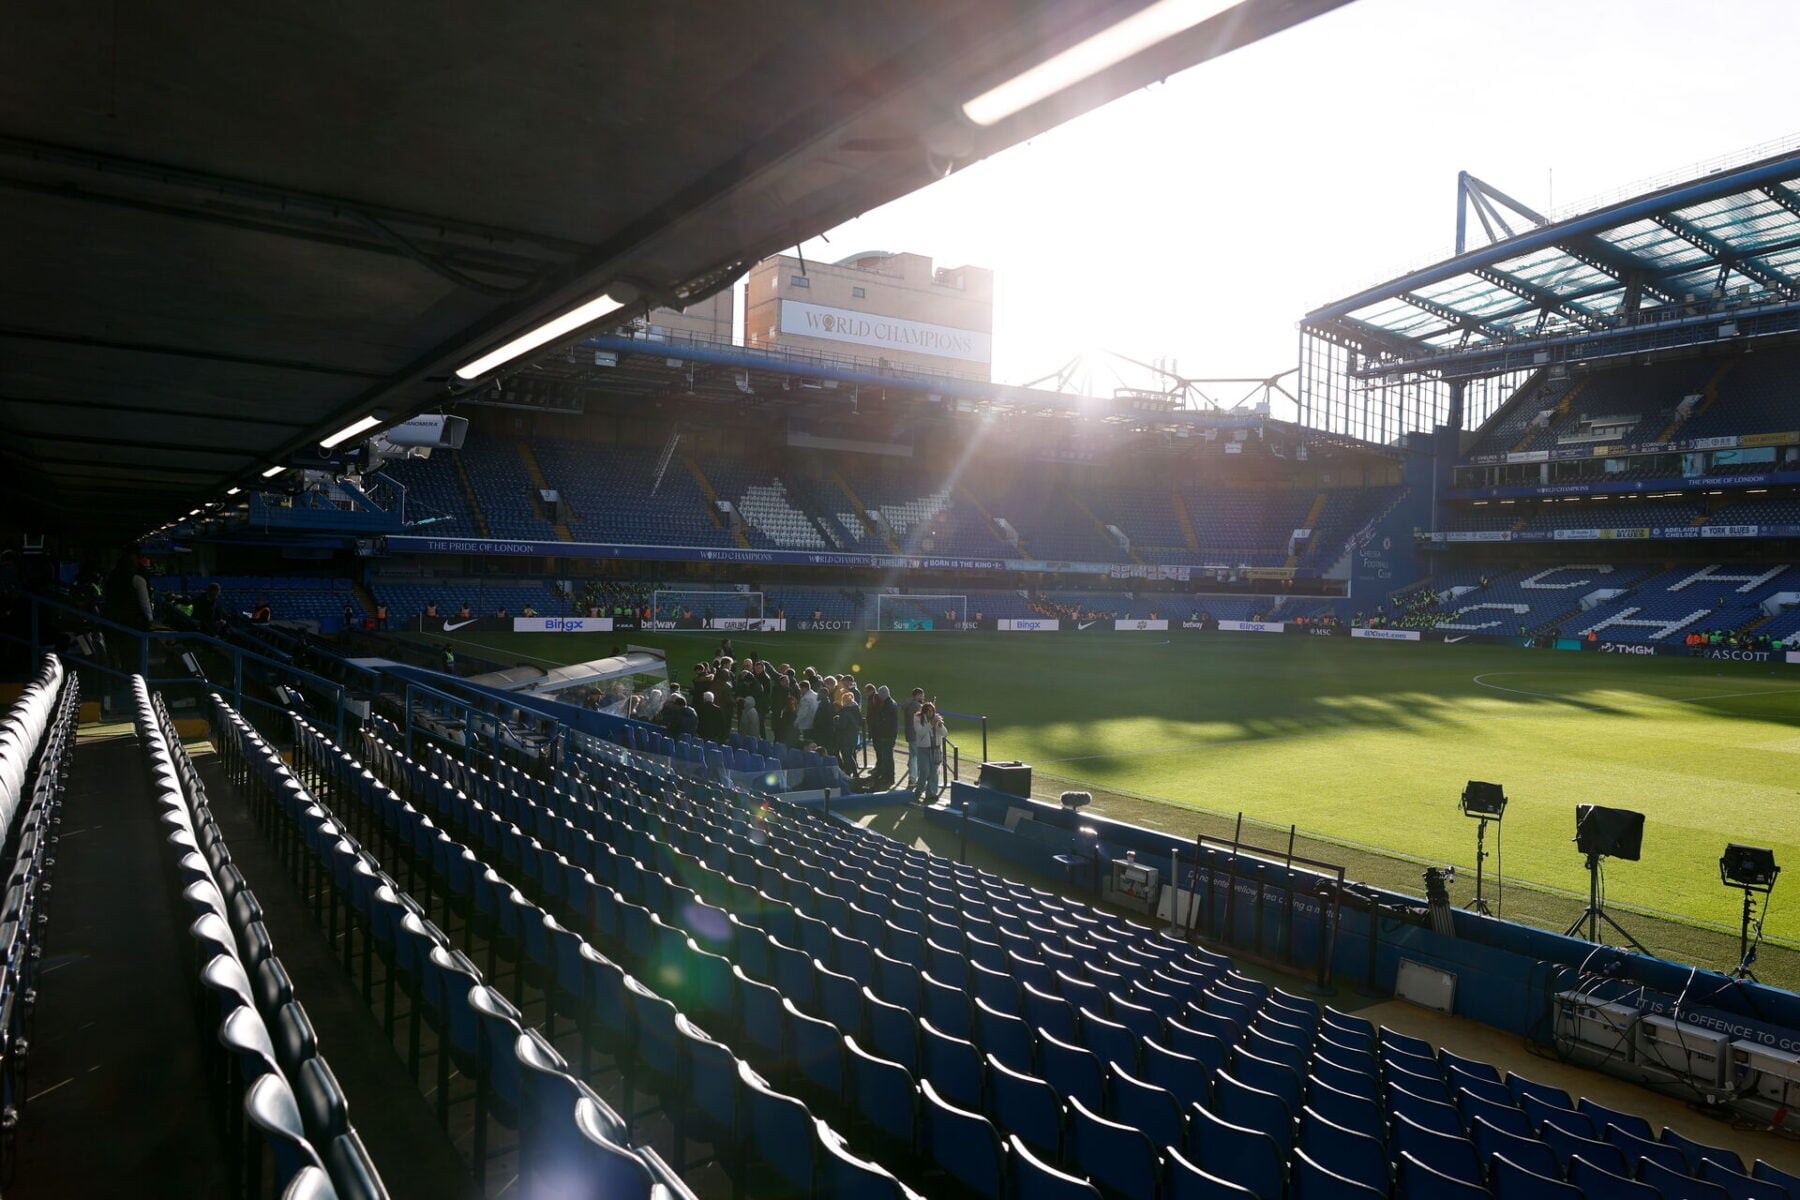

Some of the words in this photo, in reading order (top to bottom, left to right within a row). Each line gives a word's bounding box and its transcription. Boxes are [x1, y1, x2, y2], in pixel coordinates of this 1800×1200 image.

[805, 311, 870, 338] WORLD
[873, 322, 973, 354] CHAMPIONS
[429, 541, 448, 550] THE
[450, 542, 477, 552] PRIDE
[480, 543, 493, 552] OF
[495, 543, 534, 553] LONDON
[700, 551, 728, 560] WORLD
[729, 552, 773, 561] CHAMPIONS
[930, 559, 950, 567] BORN
[1616, 644, 1655, 656] TMGM
[1711, 649, 1770, 661] ASCOTT
[1635, 997, 1649, 1009] IT
[1651, 1001, 1665, 1014] IS
[1689, 1012, 1753, 1039] OFFENCE
[1756, 1031, 1776, 1045] TO
